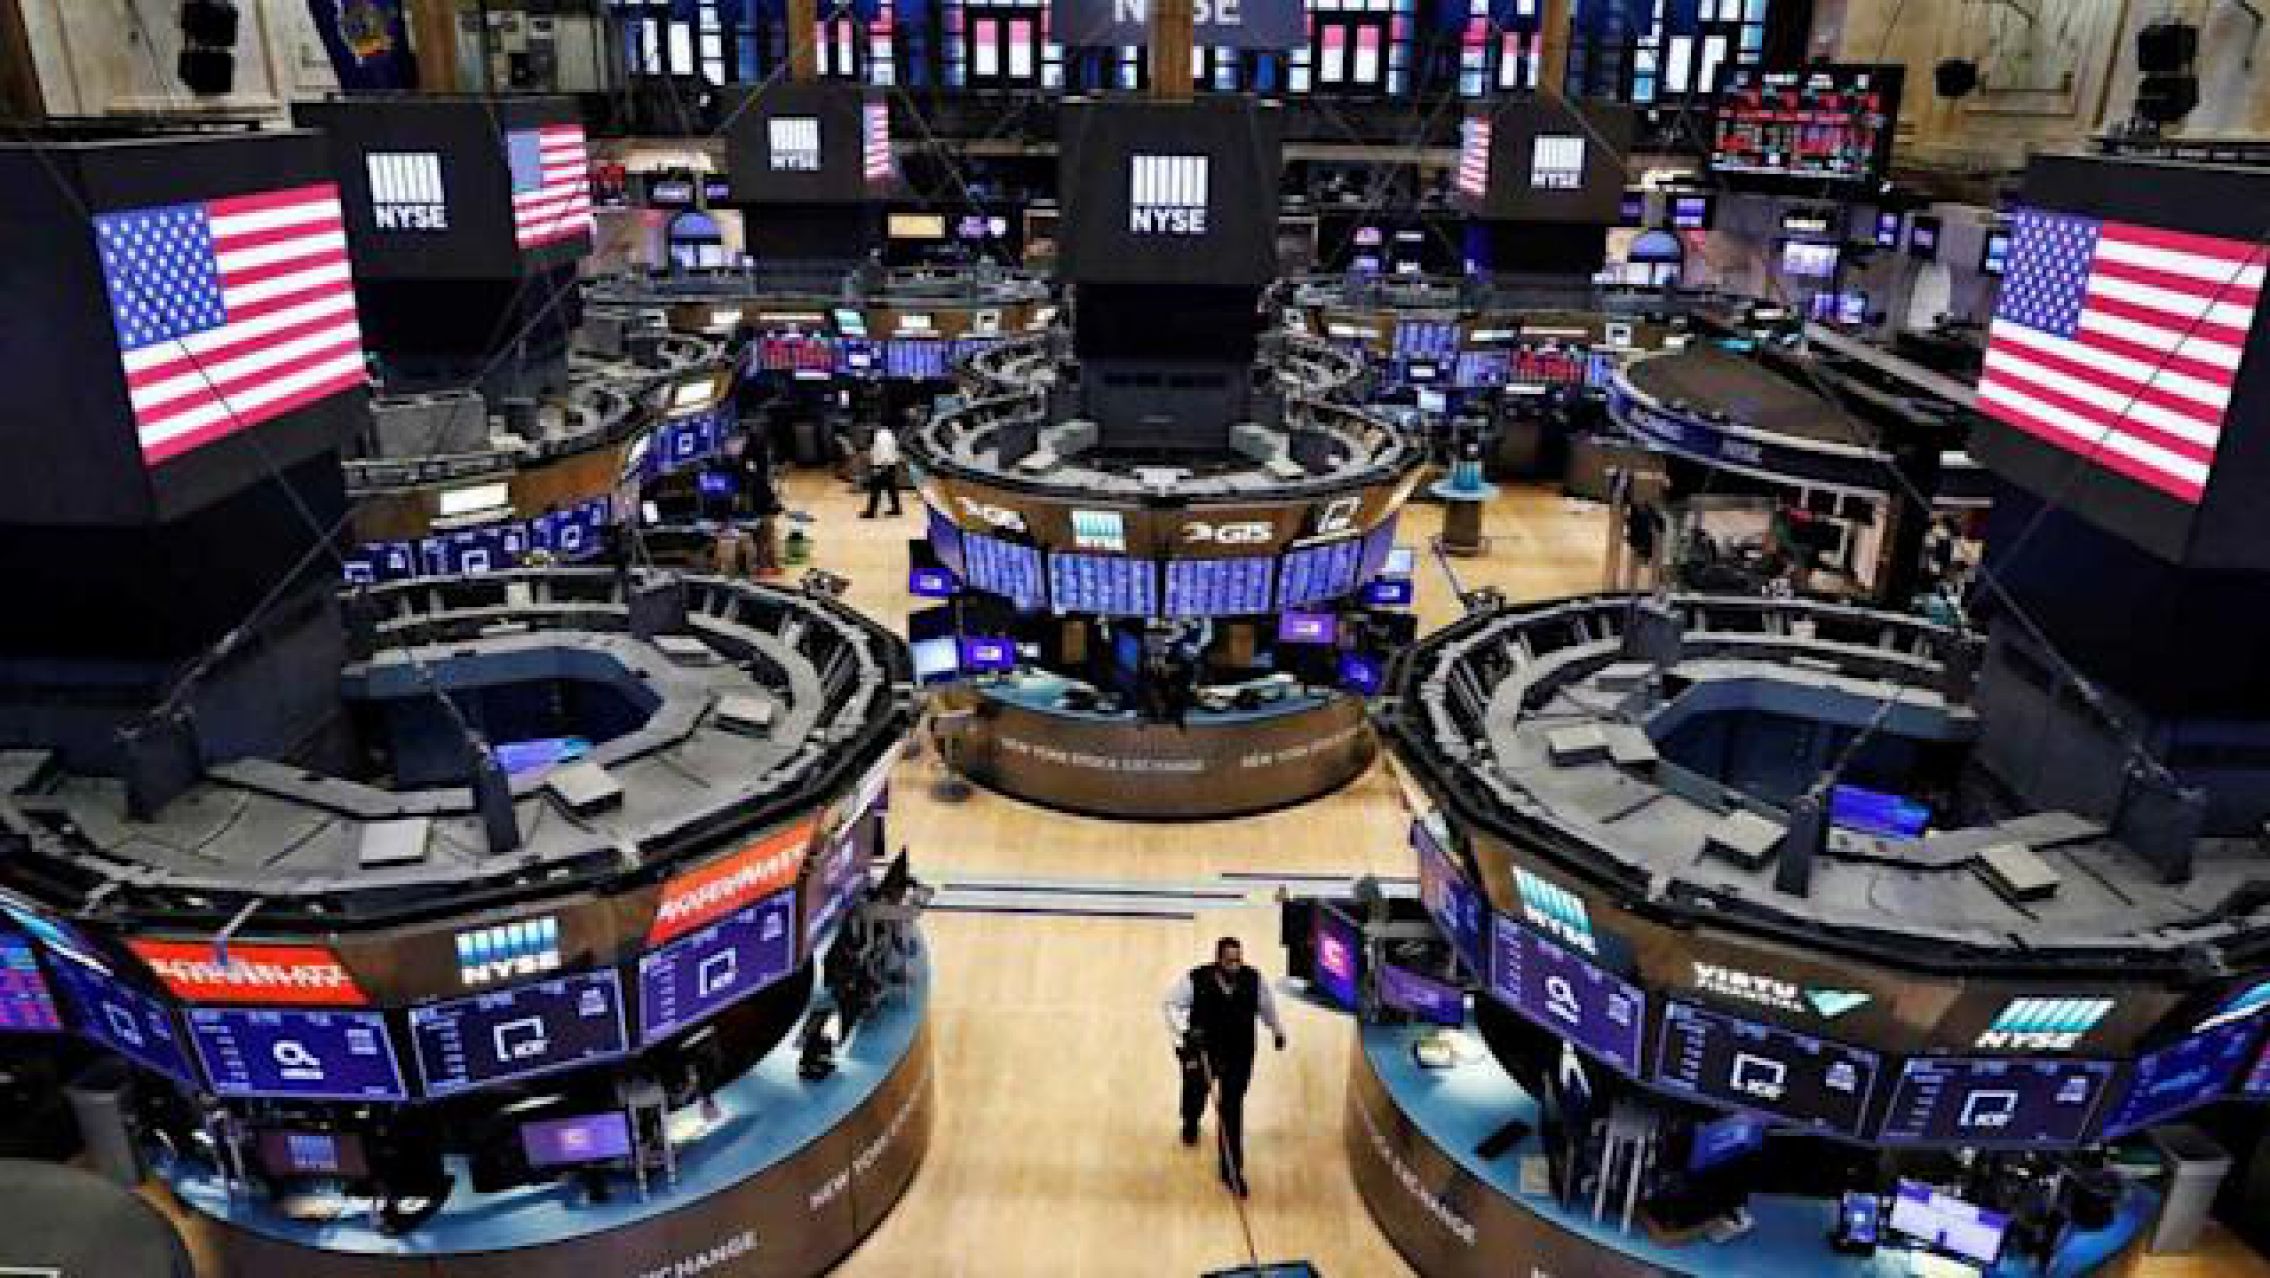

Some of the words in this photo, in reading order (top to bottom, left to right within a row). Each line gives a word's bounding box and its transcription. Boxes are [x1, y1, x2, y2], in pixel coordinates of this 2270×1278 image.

[373, 204, 448, 230] NYSE
[1130, 208, 1207, 234] NYSE
[1523, 903, 1600, 956] NYSE
[460, 947, 562, 988] NYSE
[1691, 961, 1799, 998] VIRTU
[1974, 1031, 2086, 1049] NYSE
